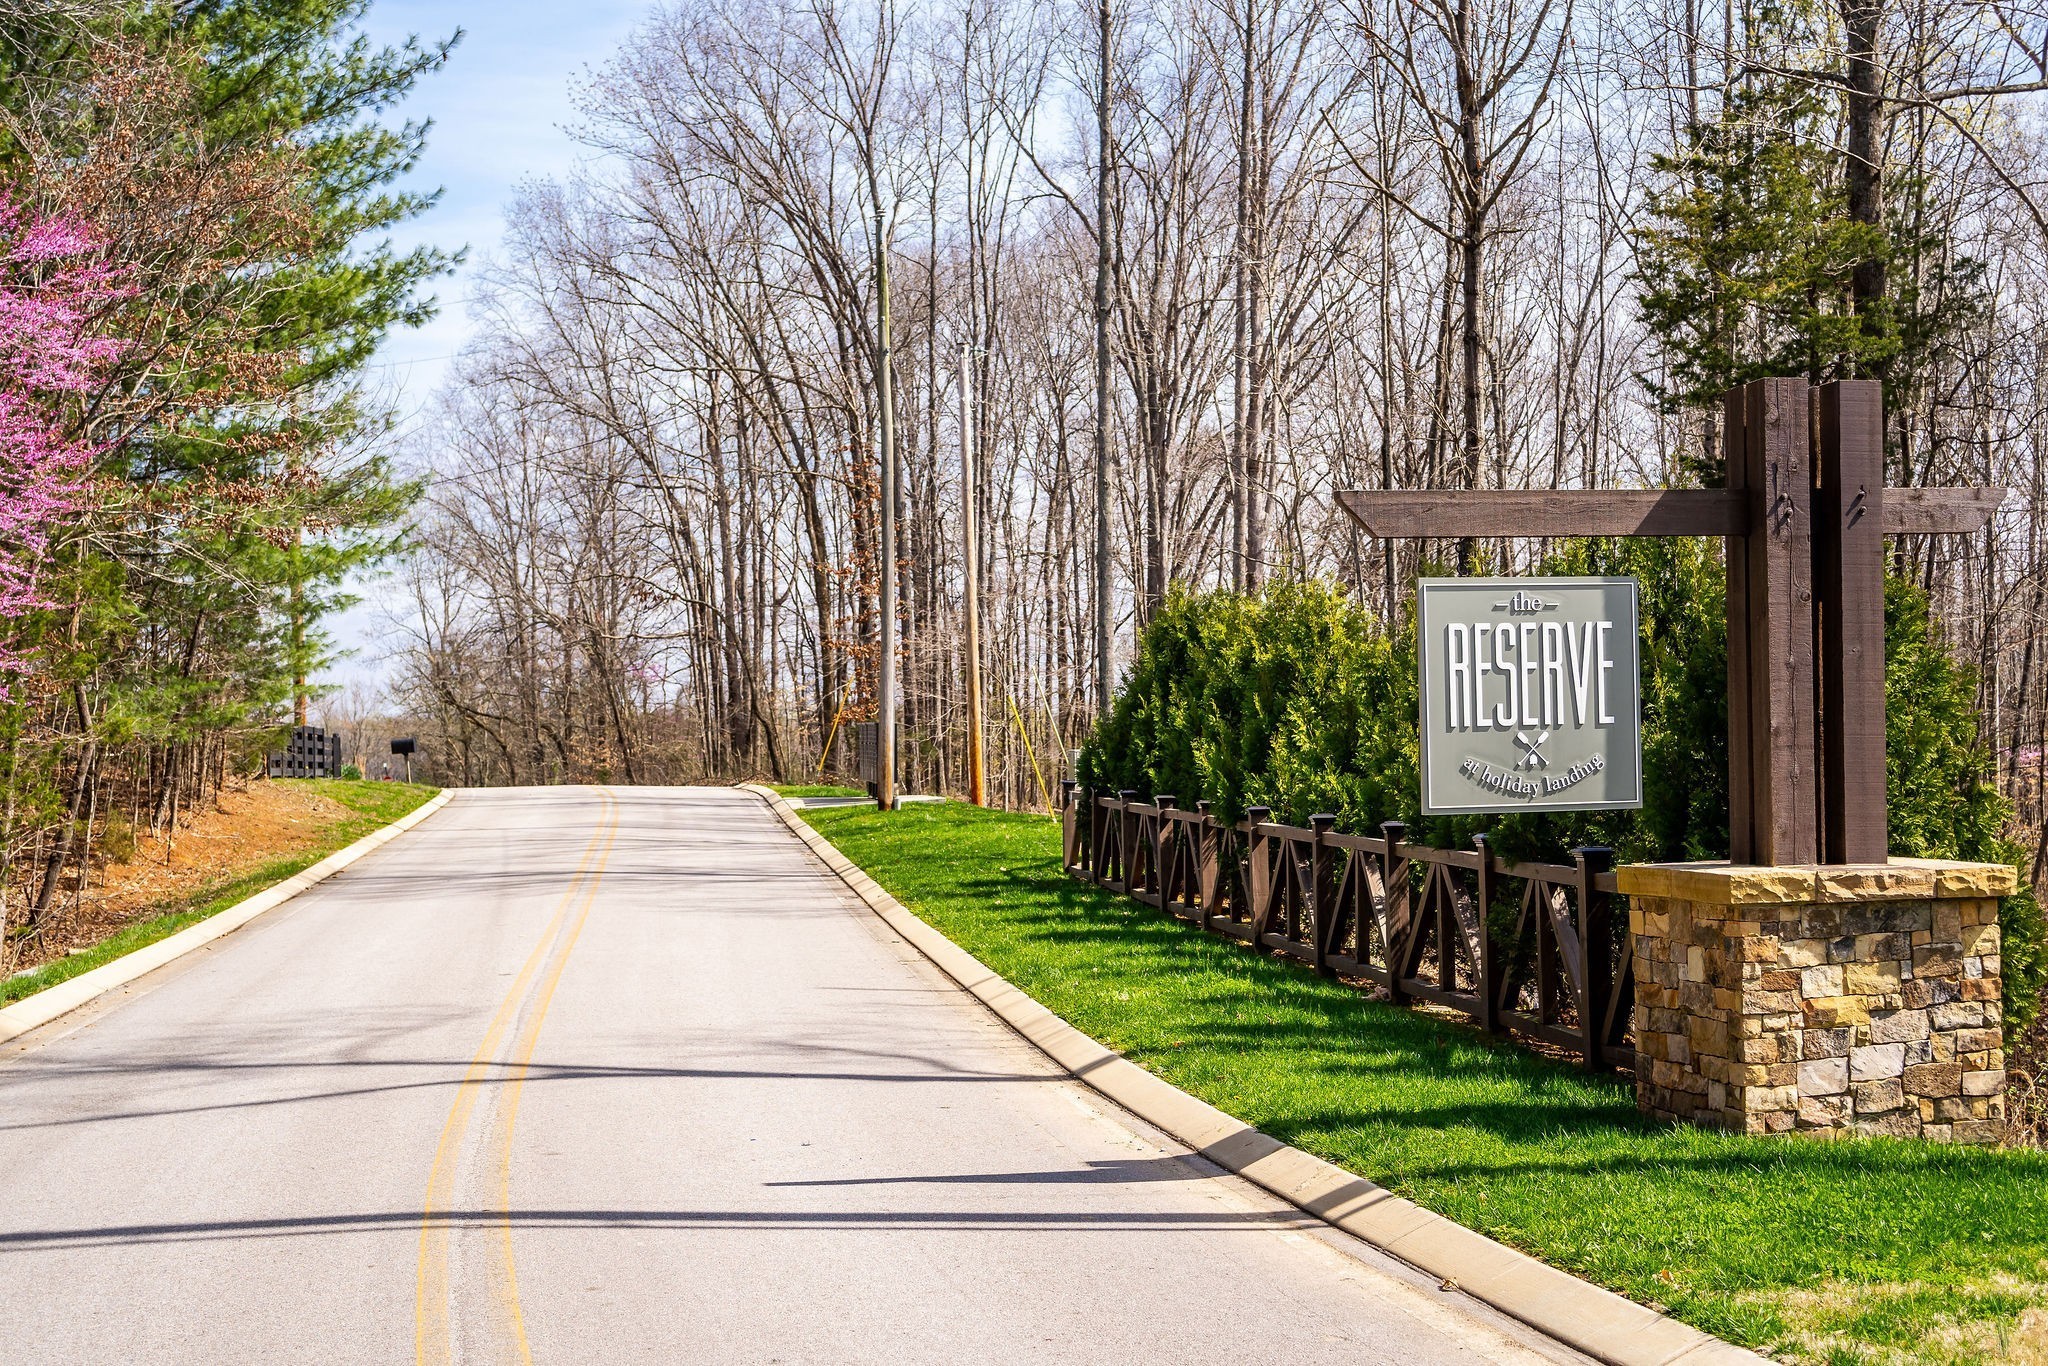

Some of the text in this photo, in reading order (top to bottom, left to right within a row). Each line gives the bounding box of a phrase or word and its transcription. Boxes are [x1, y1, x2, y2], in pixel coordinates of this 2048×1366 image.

[1513, 591, 1542, 611] the
[1448, 621, 1615, 727] RESERVE
[1463, 753, 1605, 798] at holiday landing
